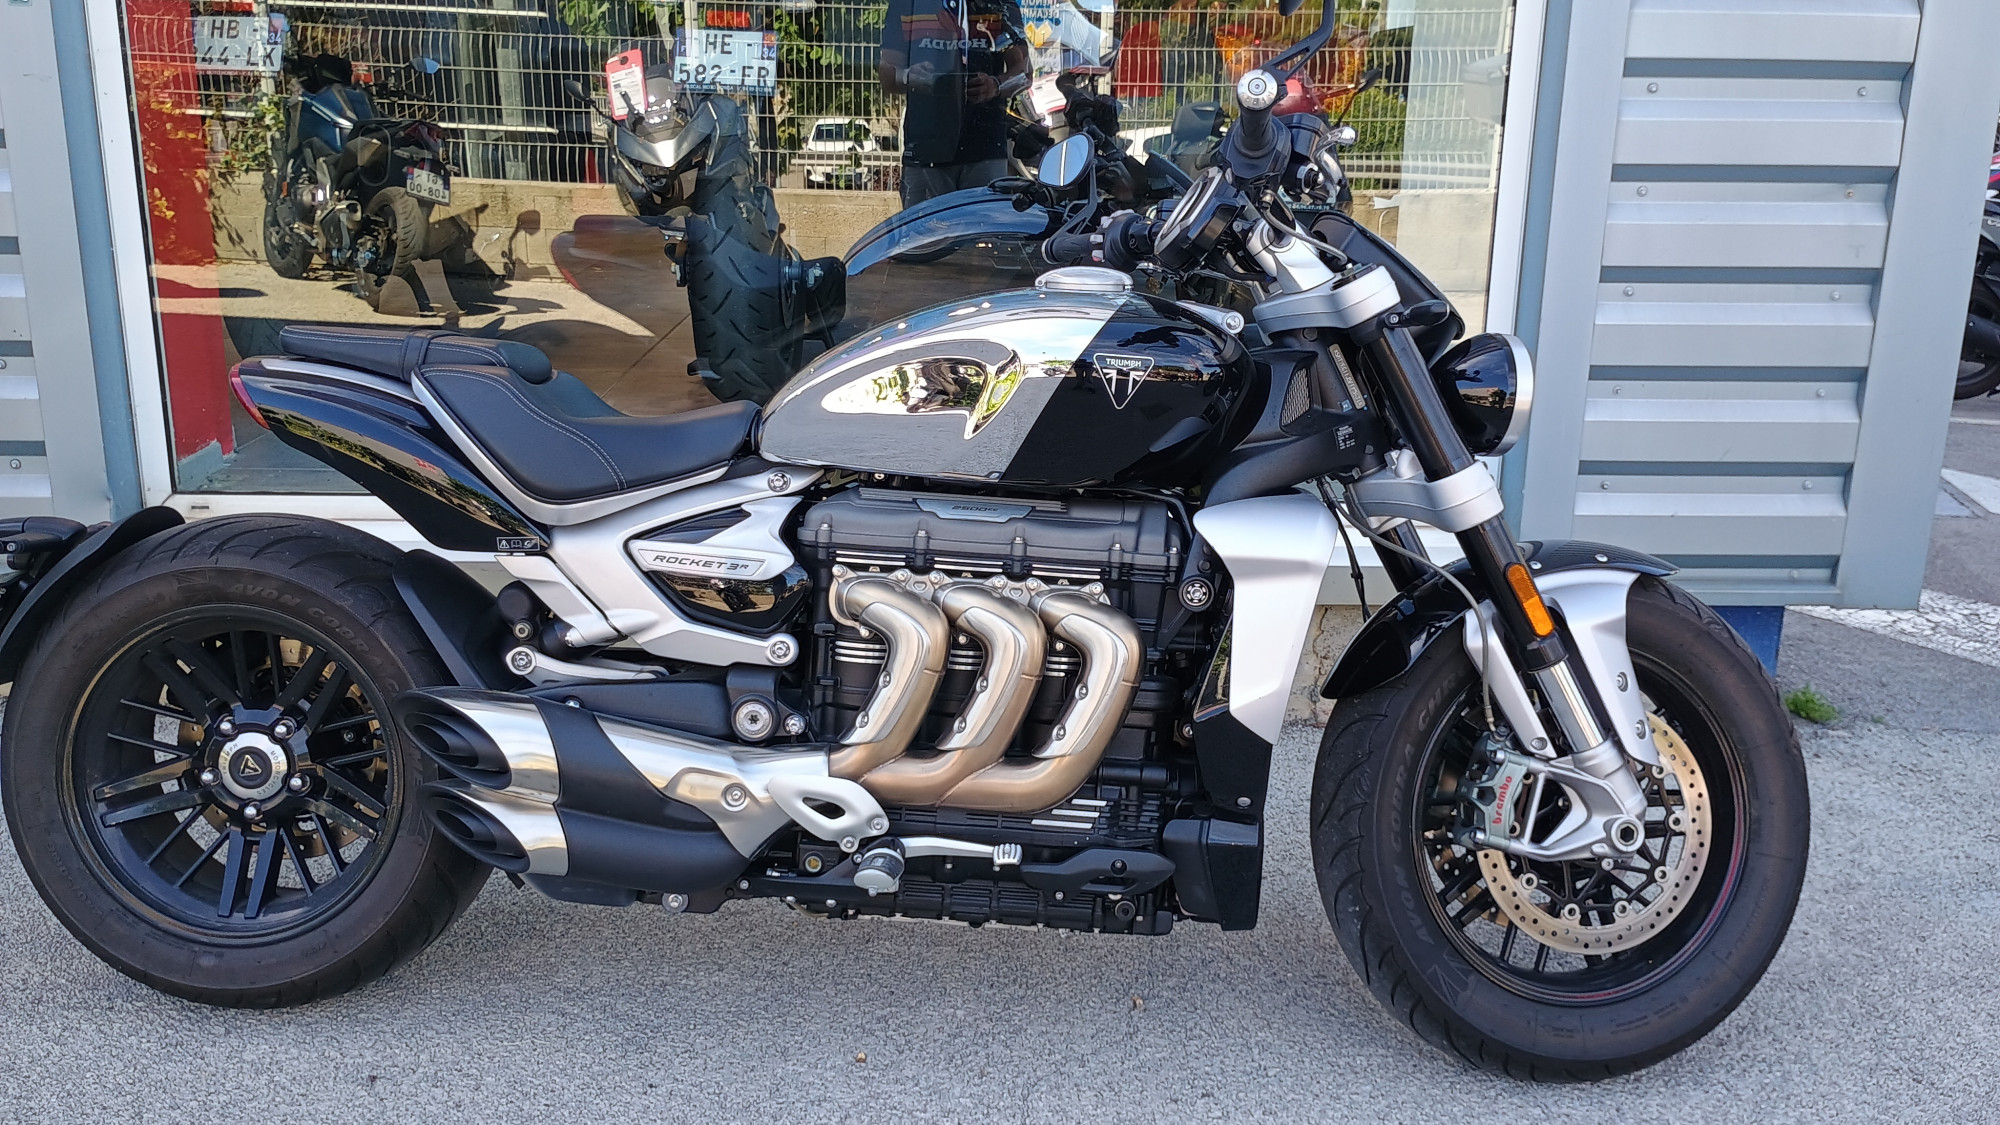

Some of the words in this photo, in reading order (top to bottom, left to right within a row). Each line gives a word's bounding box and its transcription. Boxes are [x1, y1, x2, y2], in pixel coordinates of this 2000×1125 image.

[210, 19, 240, 39] HB
[268, 32, 282, 43] 34
[705, 33, 733, 55] HE
[762, 48, 776, 58] 34
[679, 63, 770, 86] 582-FR
[1105, 358, 1142, 370] TRIUMPH
[652, 554, 728, 569] ROCKET
[227, 583, 301, 606] AVON
[1391, 743, 1416, 852] COBRA
[1491, 775, 1513, 825] brembo
[1393, 863, 1435, 946] AVON
